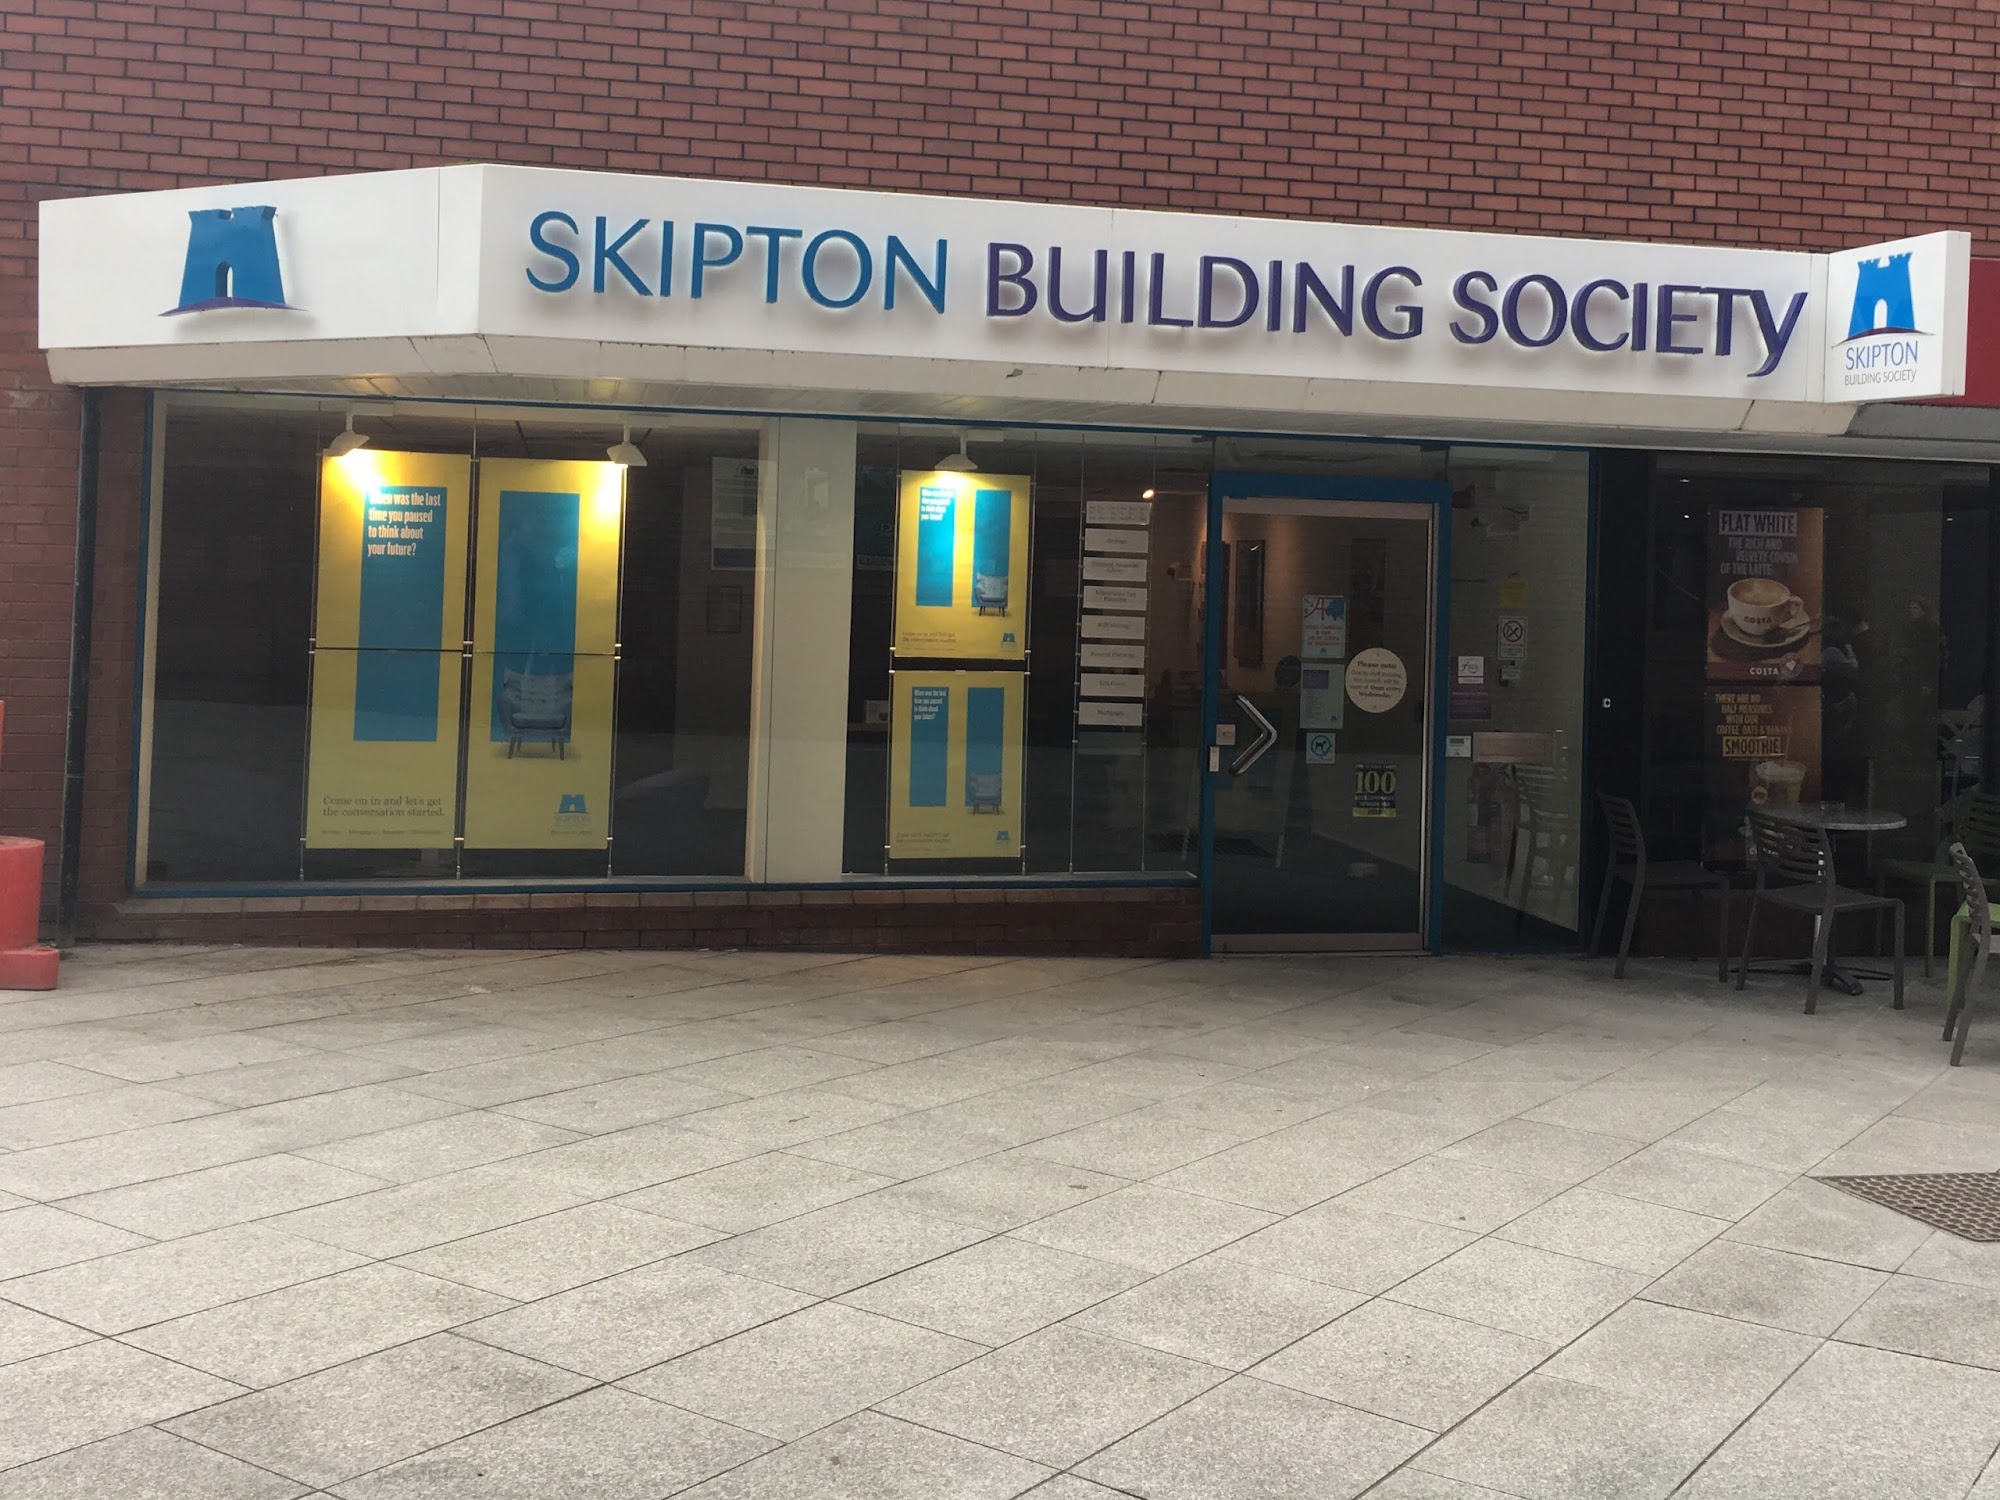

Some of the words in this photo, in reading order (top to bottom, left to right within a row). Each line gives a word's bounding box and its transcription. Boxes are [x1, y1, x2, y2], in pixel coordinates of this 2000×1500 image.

[526, 210, 948, 314] SKIPTON
[986, 241, 1424, 340] BUILDING
[1449, 270, 1808, 377] SOCIETY
[1845, 340, 1918, 370] SKIPTON
[1844, 372, 1881, 386] BUILDING
[1883, 368, 1917, 383] SOCIETY
[369, 492, 393, 505] en
[393, 493, 410, 506] was
[411, 492, 424, 506] the
[425, 492, 441, 507] last
[368, 507, 387, 522] time
[388, 510, 403, 524] you
[404, 509, 433, 524] paused
[1722, 513, 1750, 532] FLAT
[1754, 514, 1795, 533] WHITE
[368, 525, 378, 538] to
[378, 525, 399, 539] think
[400, 525, 424, 540] about
[367, 543, 386, 557] your
[387, 541, 417, 556] future?
[1744, 616, 1772, 625] COSTA
[1750, 667, 1779, 676] COSTA
[1724, 738, 1779, 755] SMOOTHIE
[1356, 770, 1396, 794] 100
[322, 795, 352, 806] Come
[354, 797, 367, 806] on
[370, 796, 381, 806] in
[383, 795, 402, 806] and
[426, 796, 442, 807] get
[322, 806, 339, 817] the
[341, 807, 404, 817] conversation
[407, 806, 445, 817] started.
